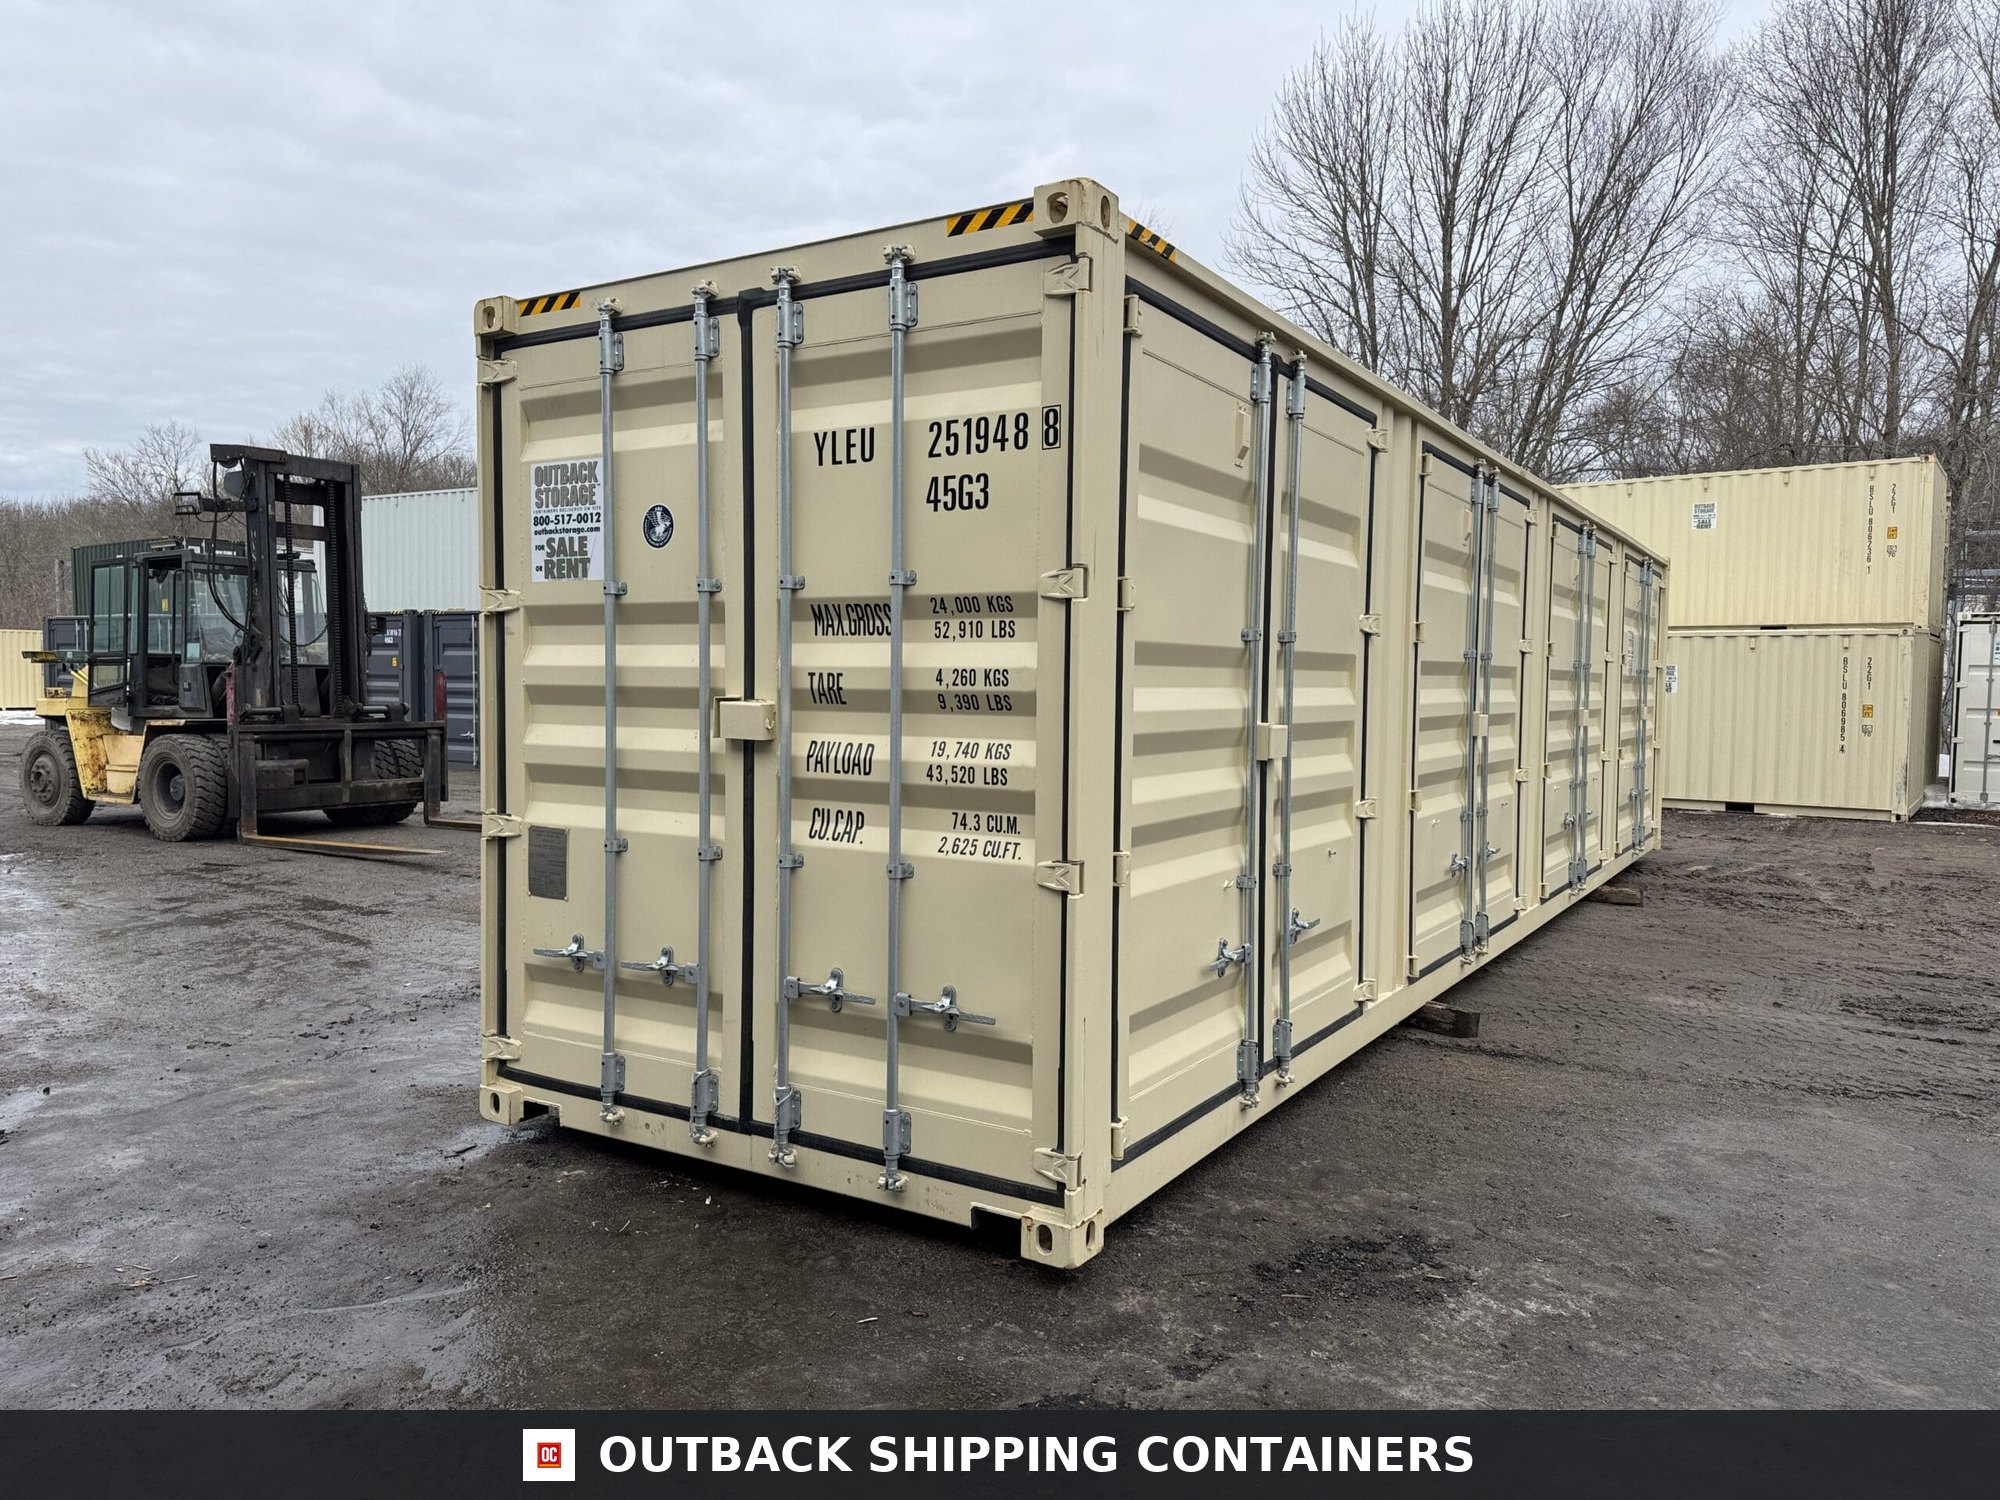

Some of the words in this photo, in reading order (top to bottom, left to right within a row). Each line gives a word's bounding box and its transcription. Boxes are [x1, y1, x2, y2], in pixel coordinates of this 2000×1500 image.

[814, 427, 875, 466] YLEU
[928, 412, 1029, 459] 251948
[1044, 408, 1059, 447] 8
[534, 461, 599, 487] OUTBACK
[534, 484, 597, 509] STORAGE
[926, 473, 990, 512] 45G3
[533, 512, 601, 527] 800-517-0012
[534, 526, 601, 536] outbackstorage.com
[546, 536, 588, 558] SALE
[544, 557, 590, 579] RENT
[810, 603, 891, 636] MAX.GROSS
[930, 596, 981, 616] 24,000
[988, 595, 1013, 613] KGS
[934, 620, 983, 641] 52,910
[991, 620, 1016, 638] LBS
[808, 672, 847, 705] TARE
[935, 668, 976, 689] 4,260
[984, 669, 1009, 687] KGS
[937, 694, 979, 712] 9,390
[987, 694, 1012, 711] LBS
[806, 740, 875, 776] PAYLOAD
[930, 741, 979, 760] 19,740
[985, 743, 1011, 760] KGS
[926, 764, 975, 785] 43,520
[983, 767, 1008, 786] LBS
[808, 807, 865, 844] CU.CAP.
[951, 812, 981, 831] 74.3
[986, 814, 1021, 835] CU.M.
[938, 836, 978, 856] 2,625
[982, 840, 1022, 860] CU.FT.
